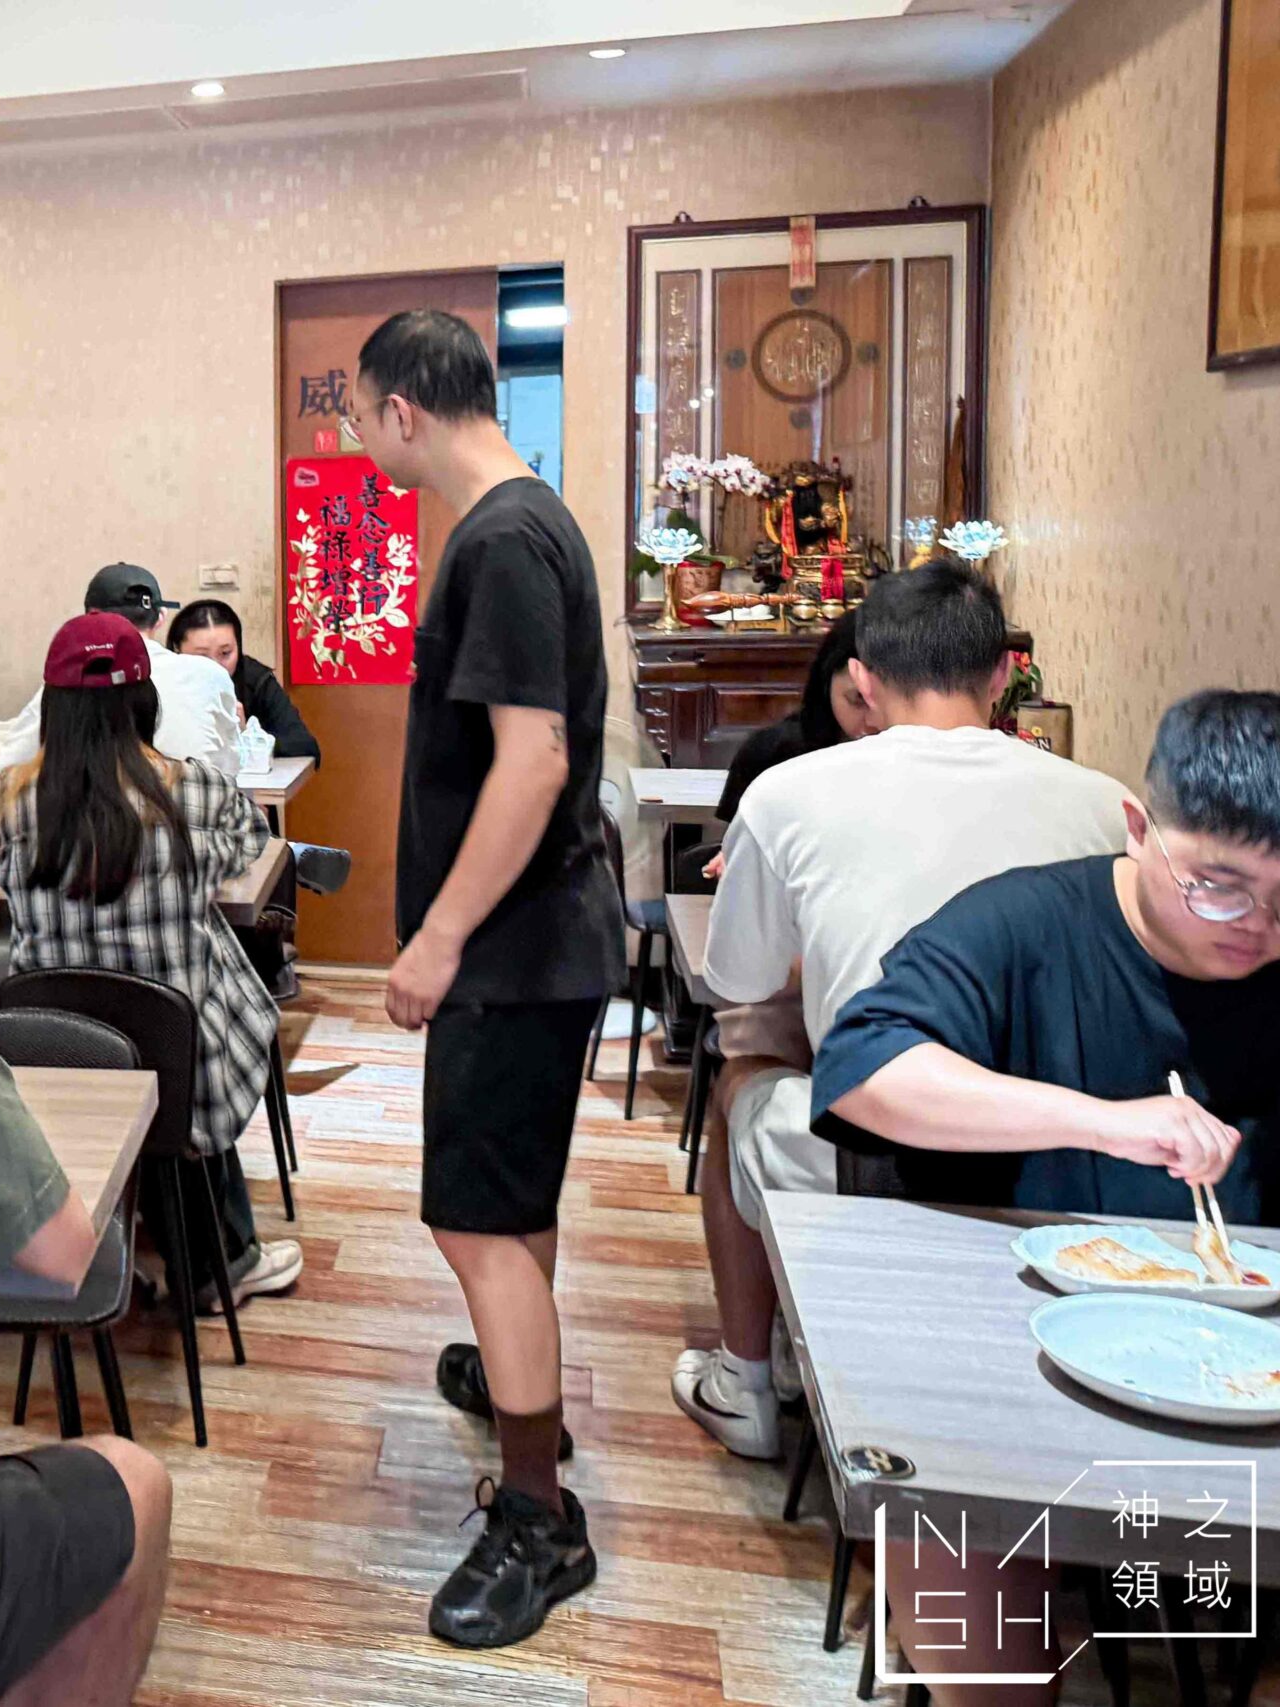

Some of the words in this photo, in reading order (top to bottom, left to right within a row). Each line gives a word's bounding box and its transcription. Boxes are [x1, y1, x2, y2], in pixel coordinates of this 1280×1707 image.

[298, 368, 349, 418] 威
[357, 472, 391, 616] 善念善行
